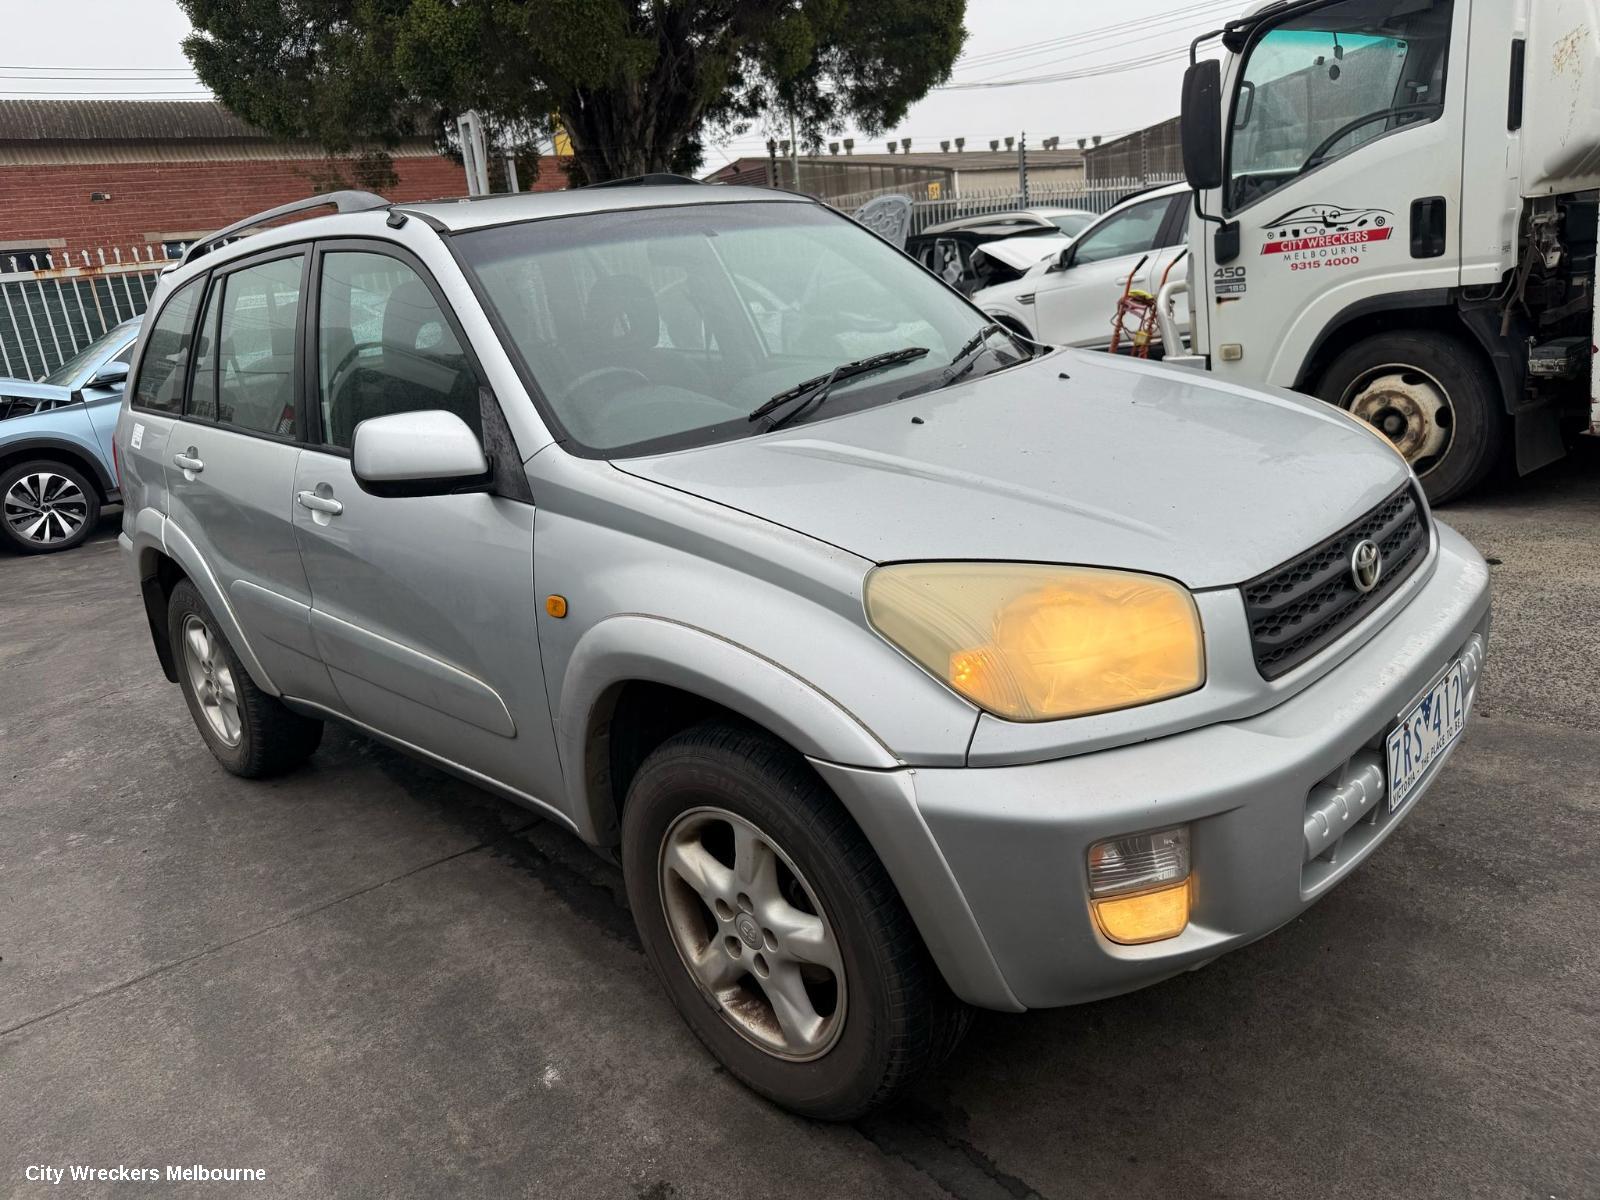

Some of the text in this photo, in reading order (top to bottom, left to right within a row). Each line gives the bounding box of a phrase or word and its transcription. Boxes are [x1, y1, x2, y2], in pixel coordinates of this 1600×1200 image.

[1280, 230, 1369, 252] CITY WRECKERS
[1283, 244, 1367, 261] MELBOURNE
[1214, 266, 1246, 278] 450
[1290, 255, 1359, 271] 9315 4000
[1392, 674, 1461, 792] ZRS 412
[1392, 771, 1416, 805] VICTORIA
[1421, 752, 1430, 770] THE
[1430, 734, 1446, 759] PLACE
